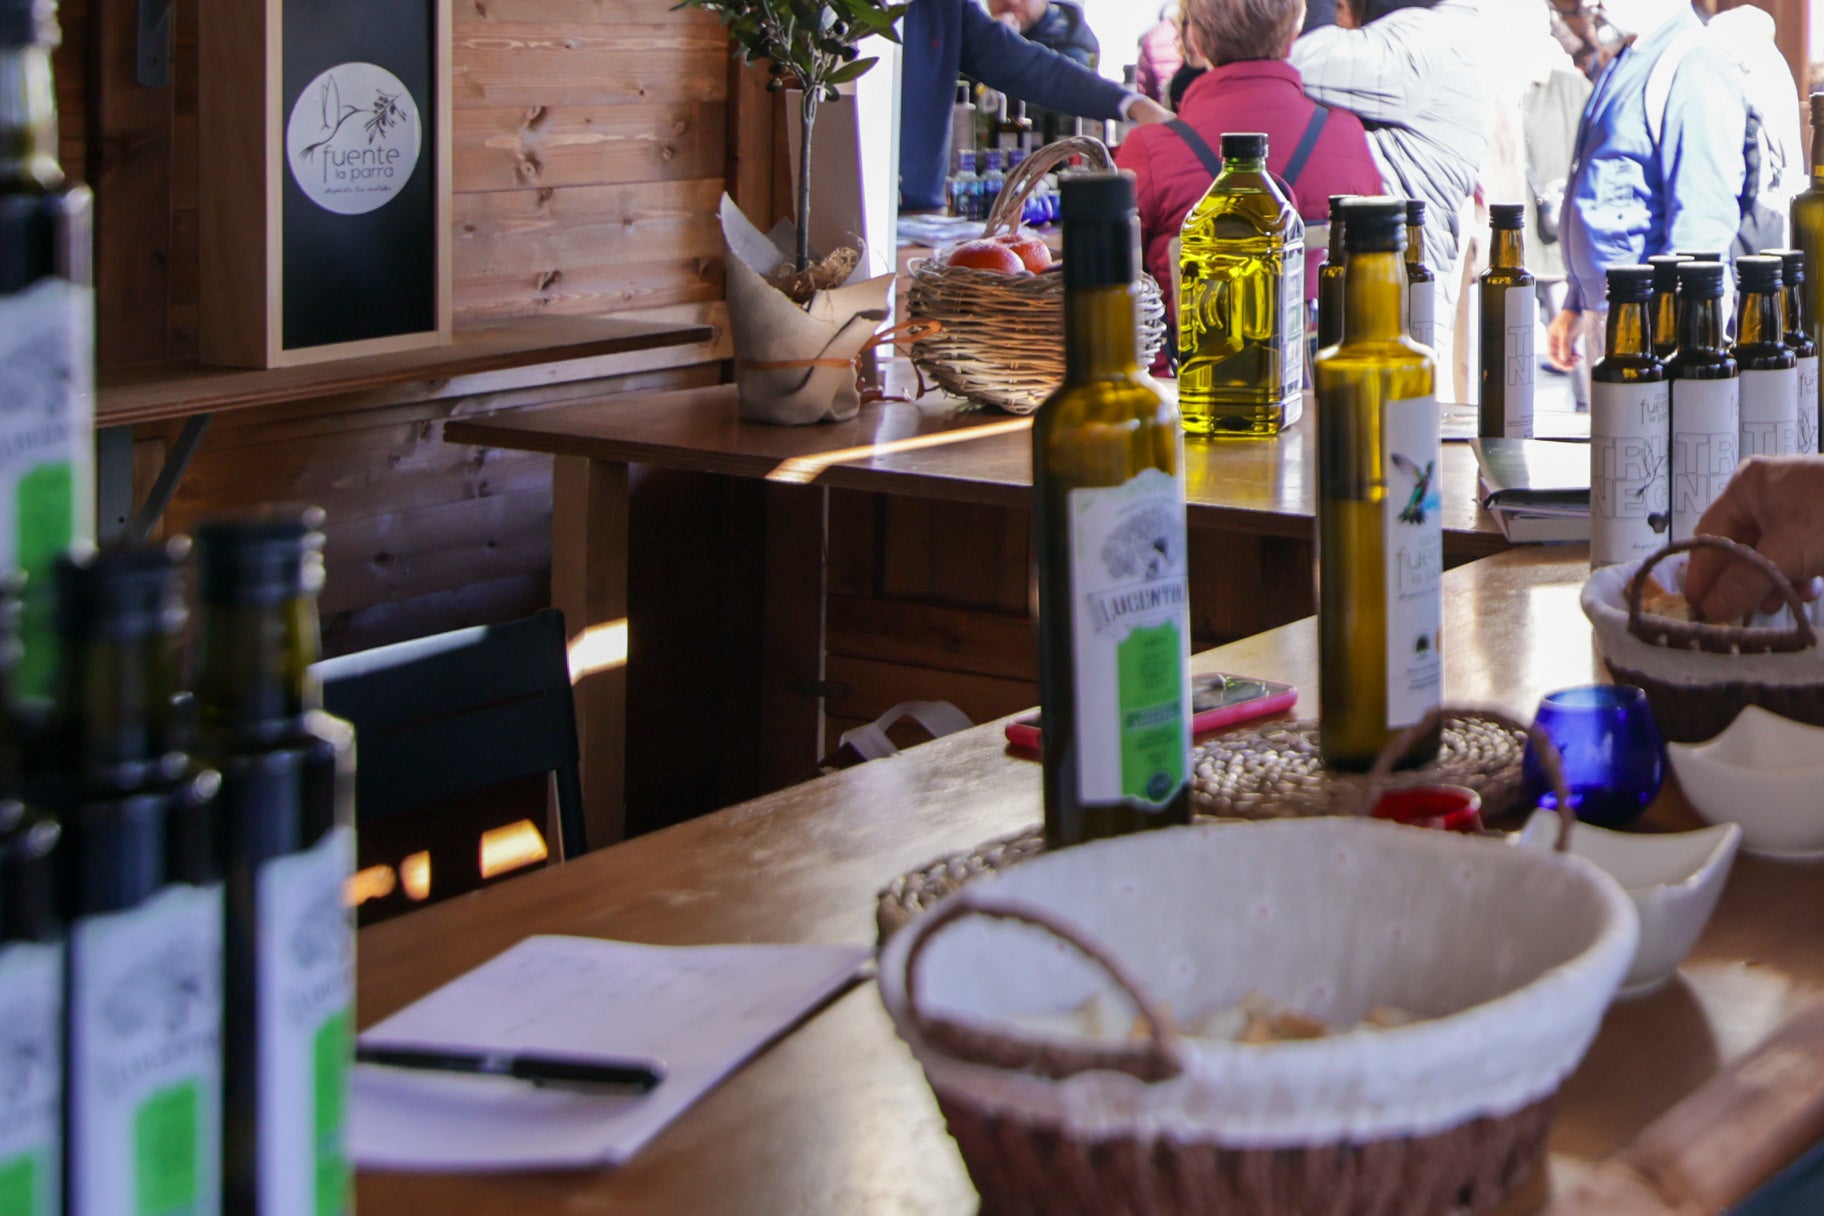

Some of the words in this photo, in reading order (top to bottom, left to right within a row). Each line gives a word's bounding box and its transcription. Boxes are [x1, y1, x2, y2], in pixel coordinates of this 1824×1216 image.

[323, 145, 400, 183] fuente
[336, 167, 346, 180] la
[350, 166, 394, 182] parra
